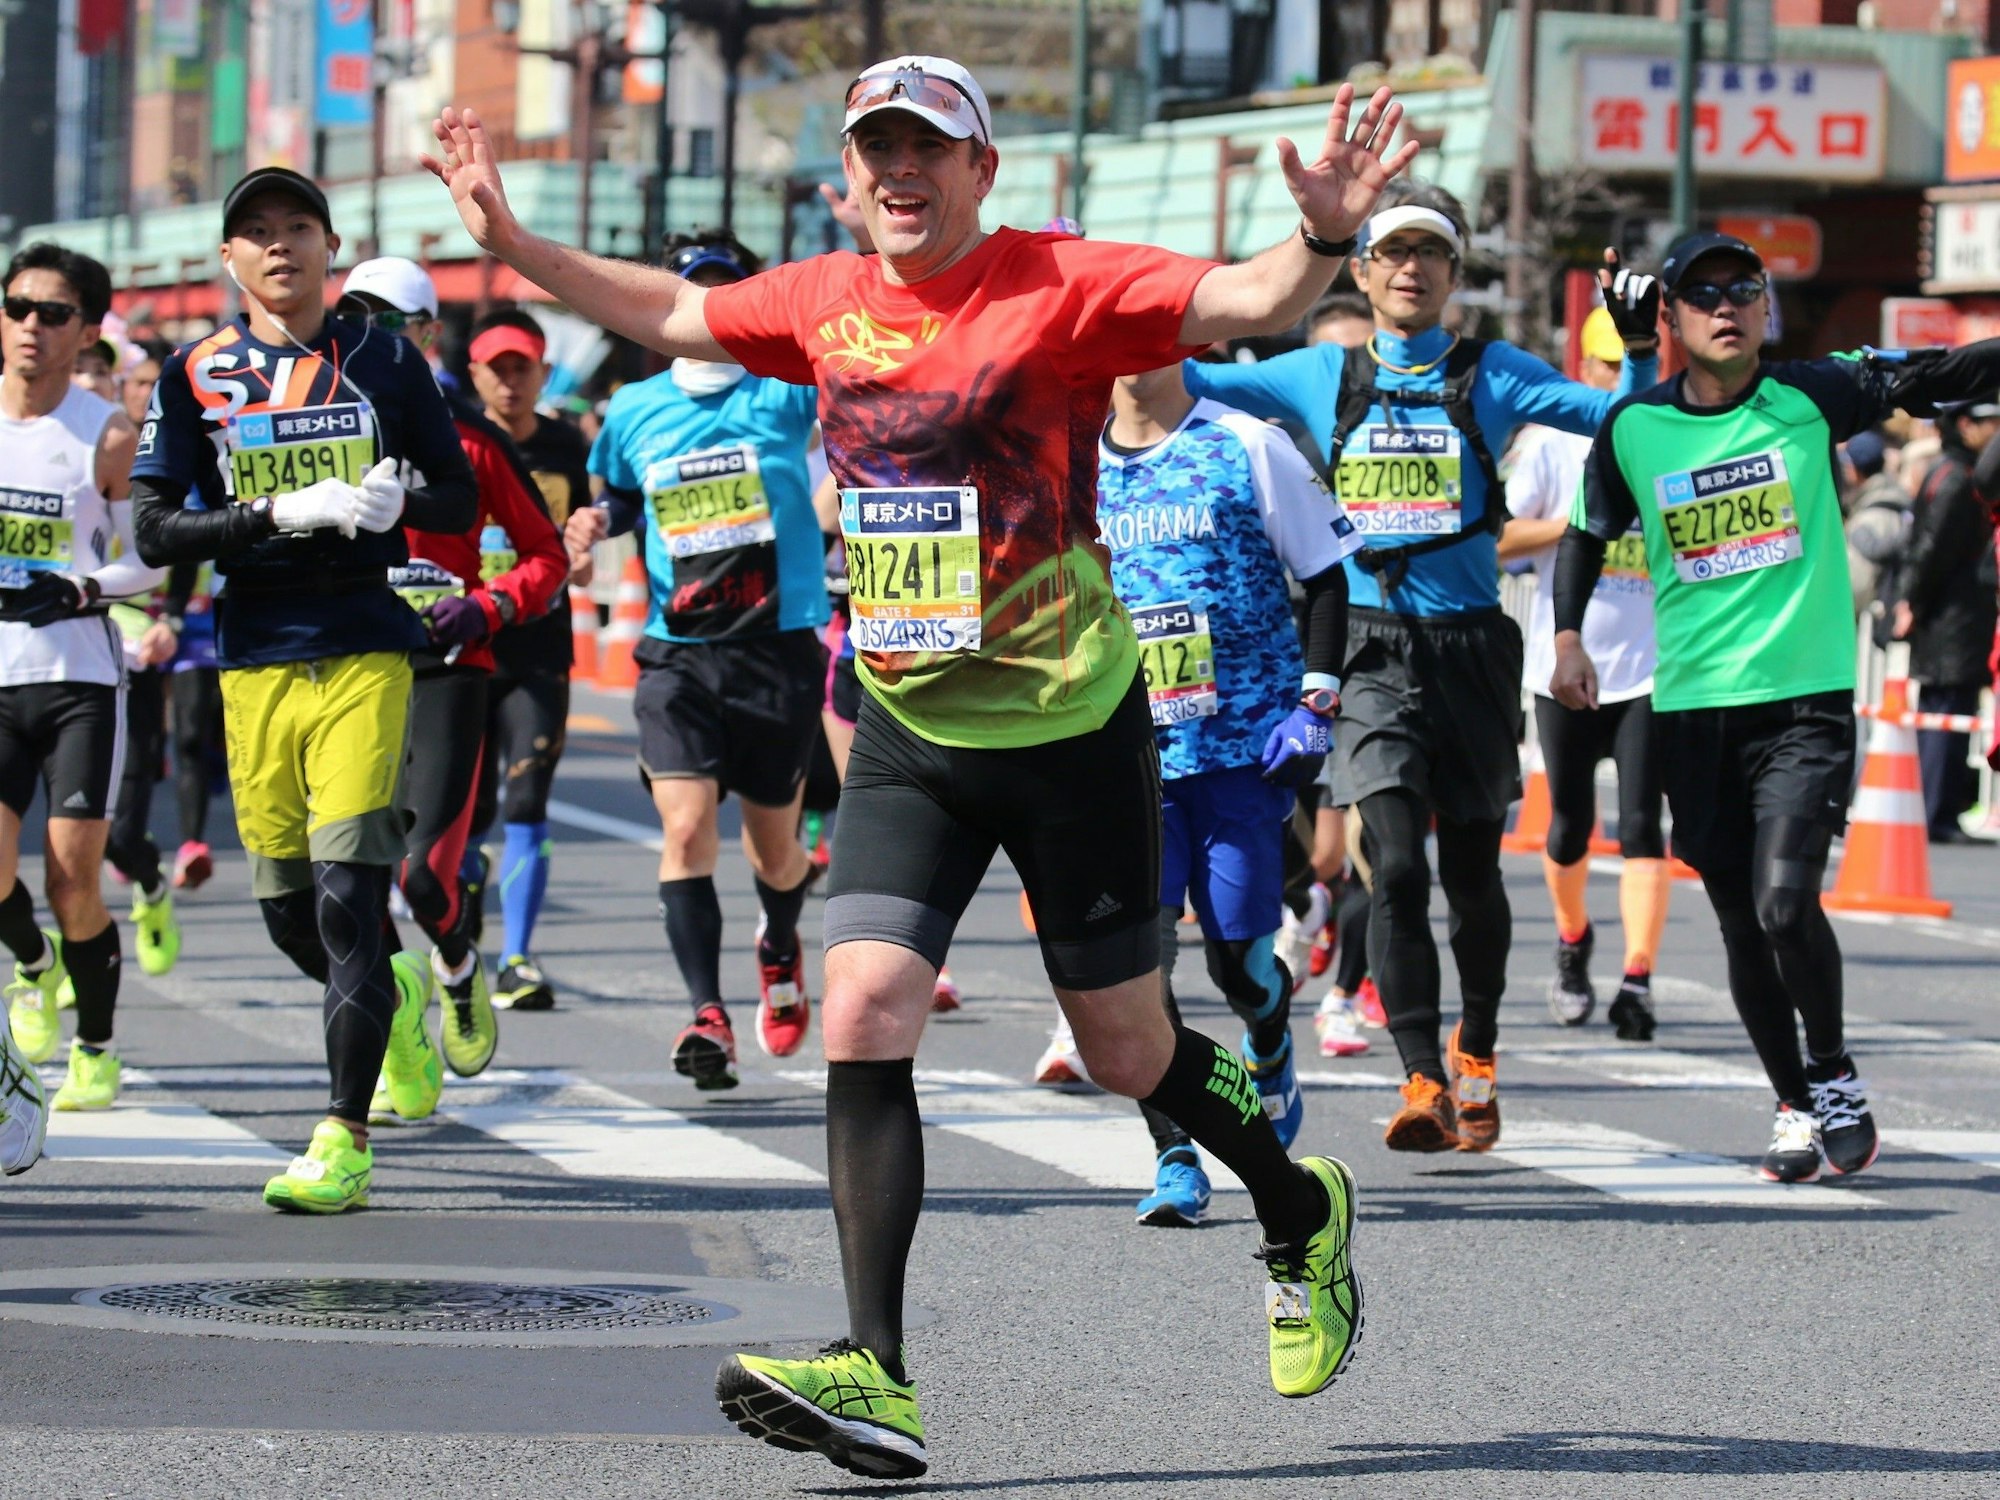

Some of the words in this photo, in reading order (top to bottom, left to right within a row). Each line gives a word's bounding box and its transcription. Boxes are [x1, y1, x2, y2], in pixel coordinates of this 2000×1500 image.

[277, 414, 356, 436] 東京メトロ
[237, 444, 350, 495] H34991
[1340, 461, 1438, 497] E27008
[1697, 461, 1770, 491] 東京メトロ
[862, 502, 952, 523] 東京メトロ
[1664, 490, 1773, 549] E27286
[873, 605, 900, 618] GATE
[904, 605, 911, 617] 2
[960, 605, 974, 616] 31
[1304, 724, 1314, 752] TOKYO
[1318, 726, 1328, 752] 2016
[1085, 900, 1122, 921] adidas
